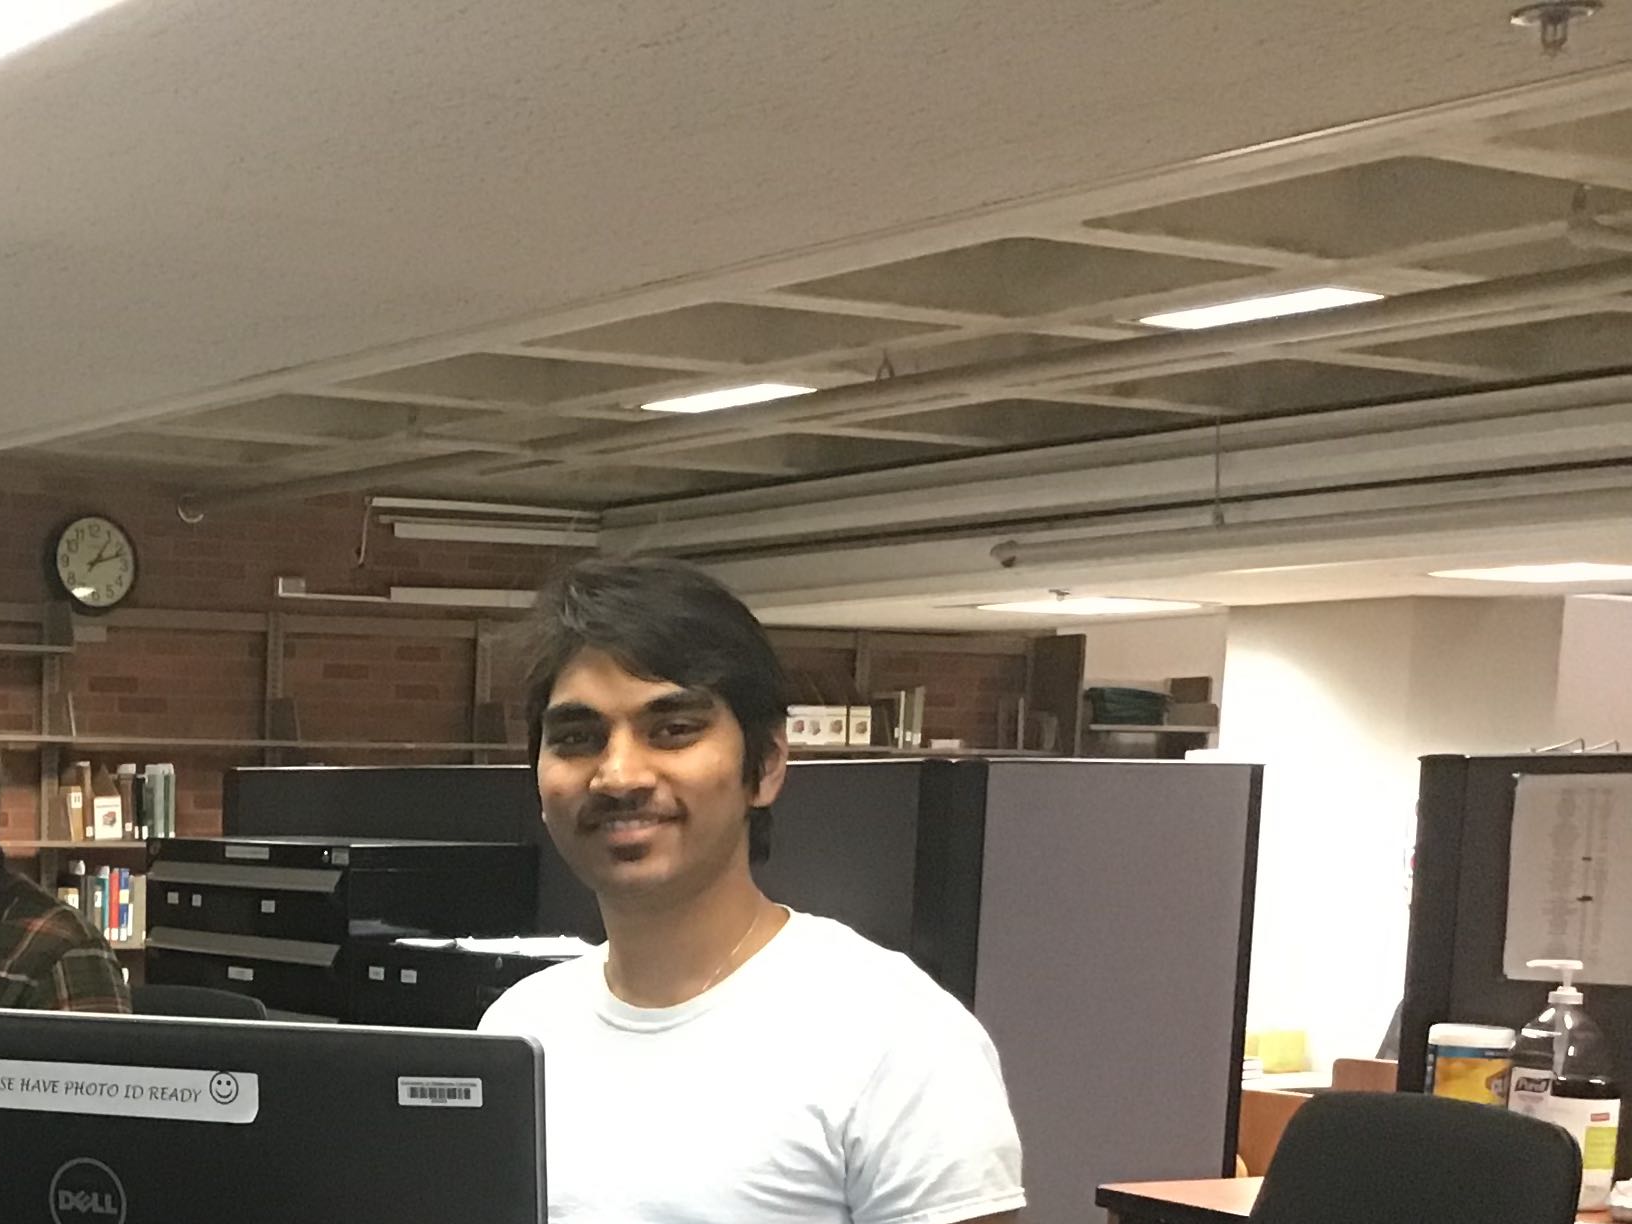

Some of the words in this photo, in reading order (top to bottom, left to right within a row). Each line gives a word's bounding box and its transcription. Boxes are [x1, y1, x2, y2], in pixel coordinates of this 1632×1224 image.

[20, 1078, 59, 1094] HAVE
[64, 1081, 120, 1098] PHOTO
[124, 1084, 144, 1100] ID
[149, 1086, 203, 1103] READY
[58, 1189, 118, 1215] DELL
